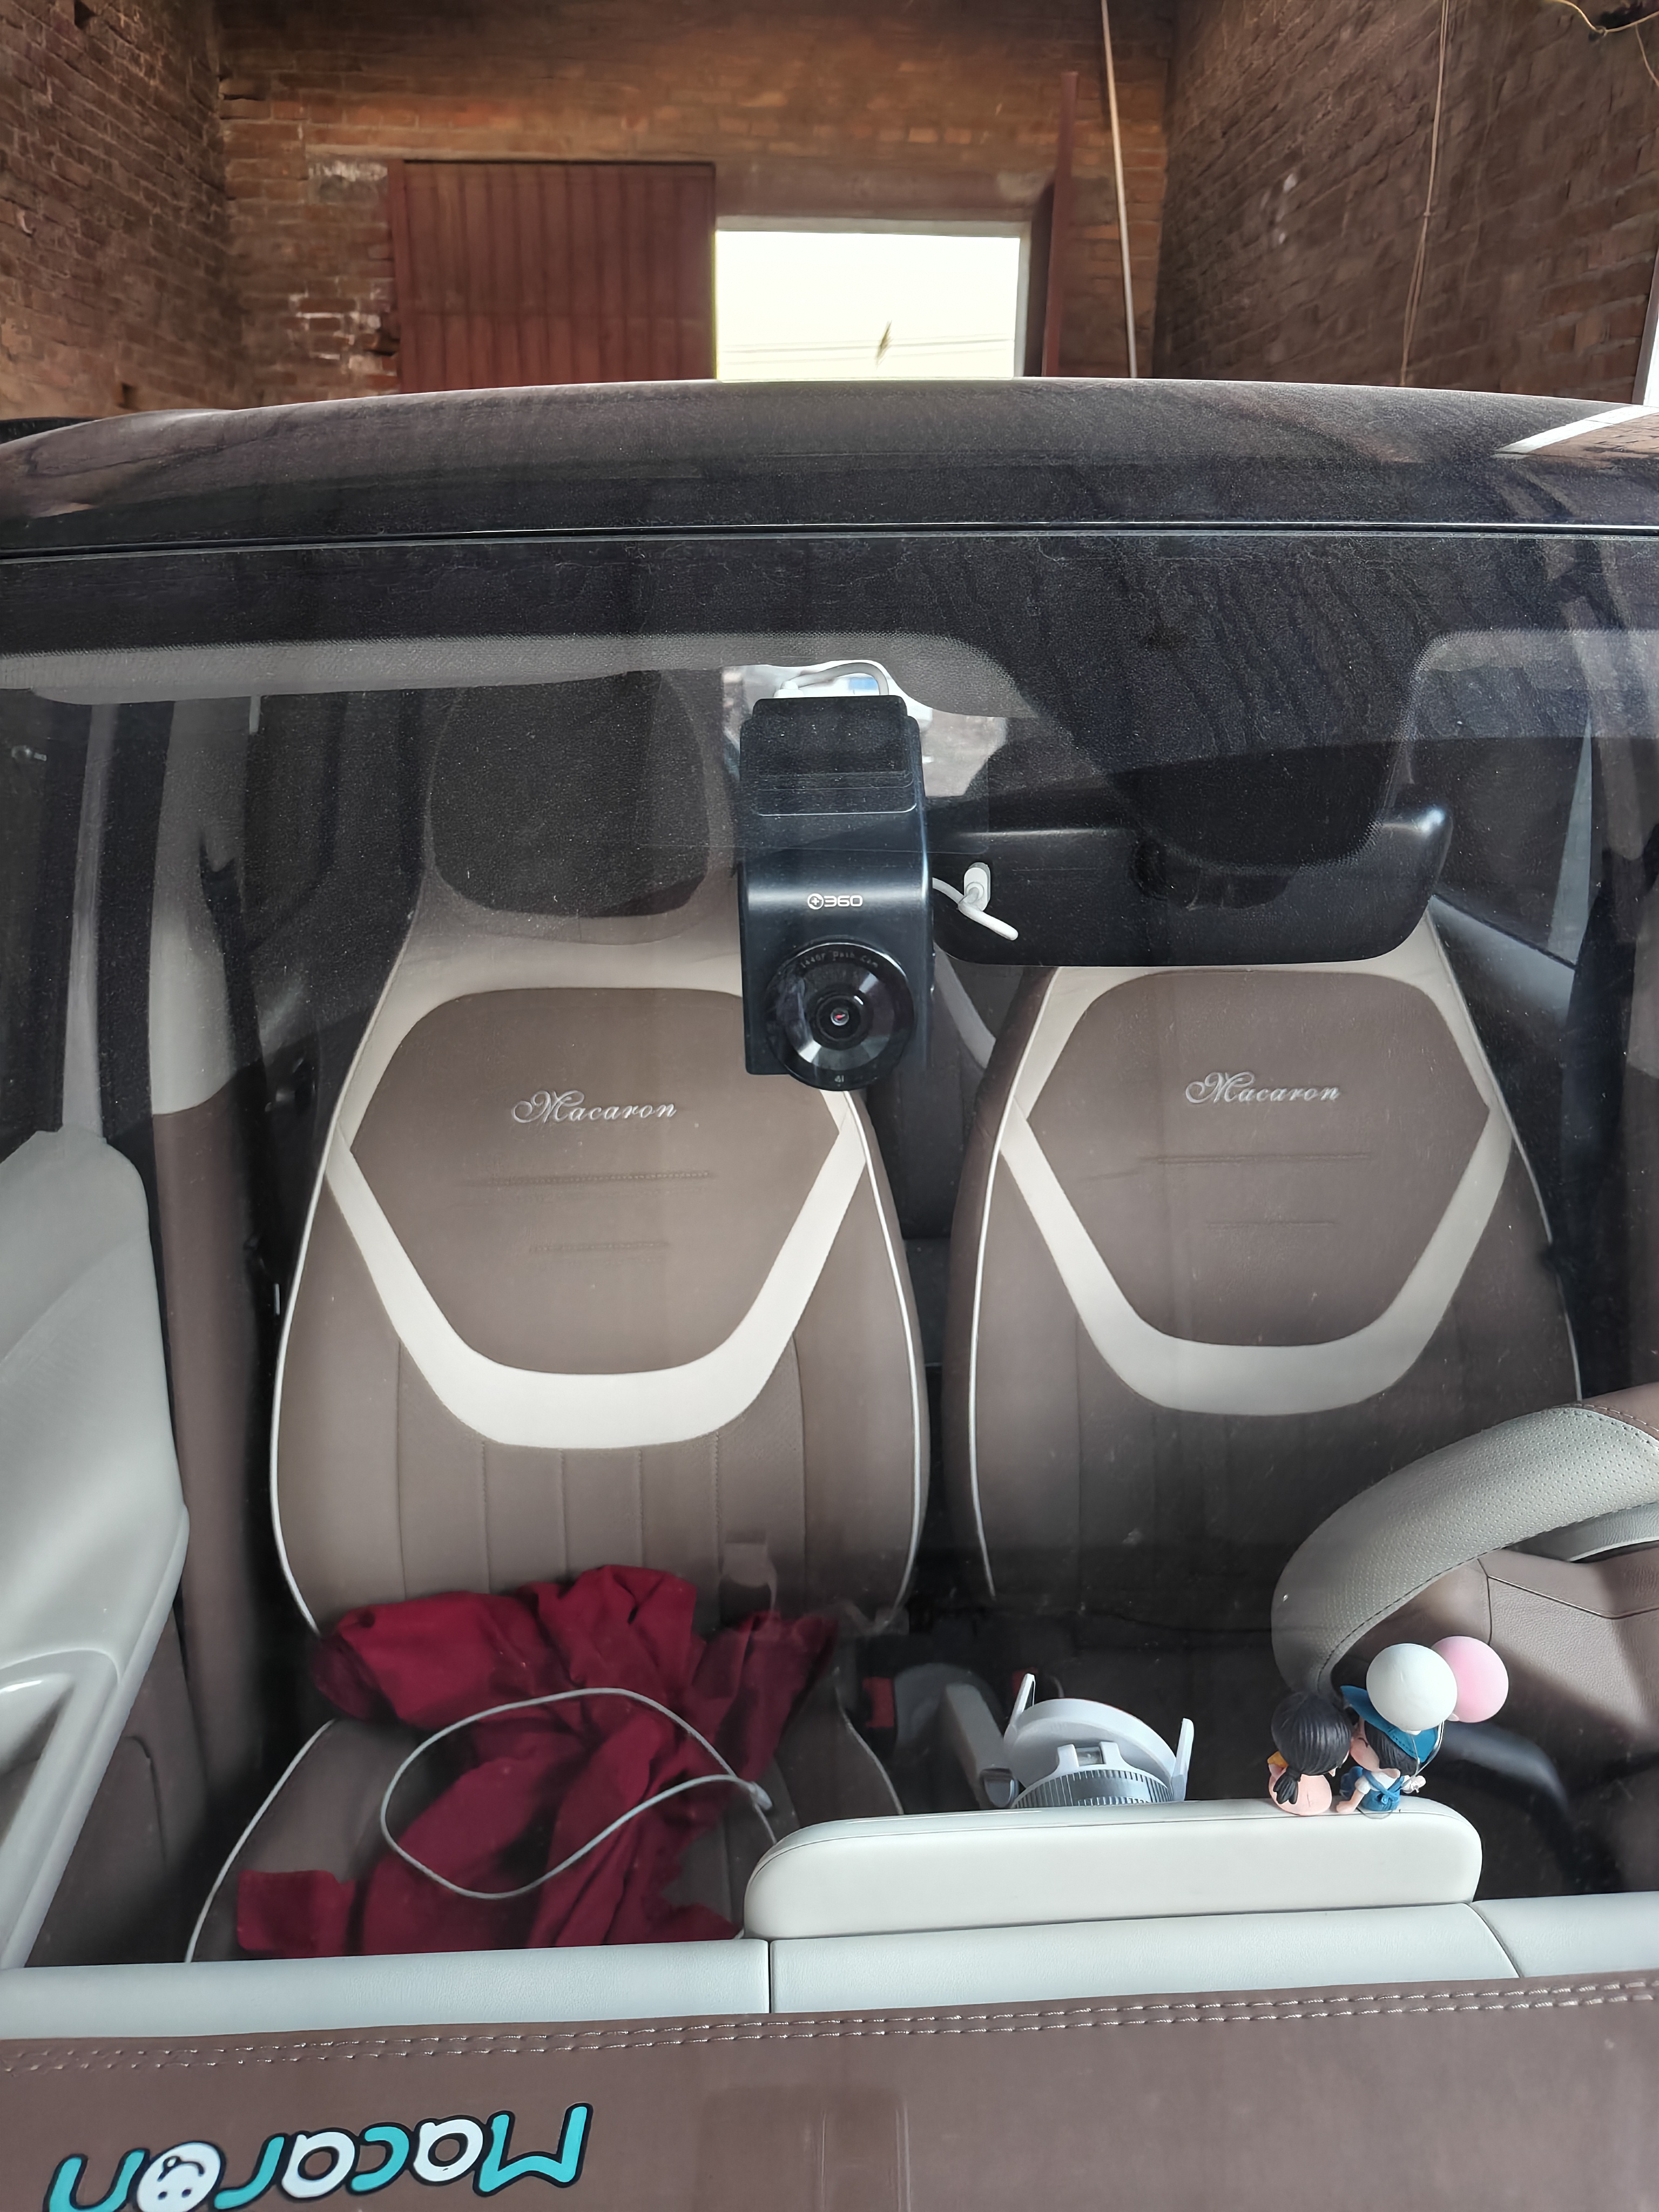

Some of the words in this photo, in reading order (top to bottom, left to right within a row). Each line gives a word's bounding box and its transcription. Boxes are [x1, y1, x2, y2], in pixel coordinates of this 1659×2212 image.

[823, 895, 863, 907] 360
[1185, 1071, 1340, 1103] Macaron
[512, 1090, 677, 1123] Macaron
[44, 2102, 593, 2212] Macaron
